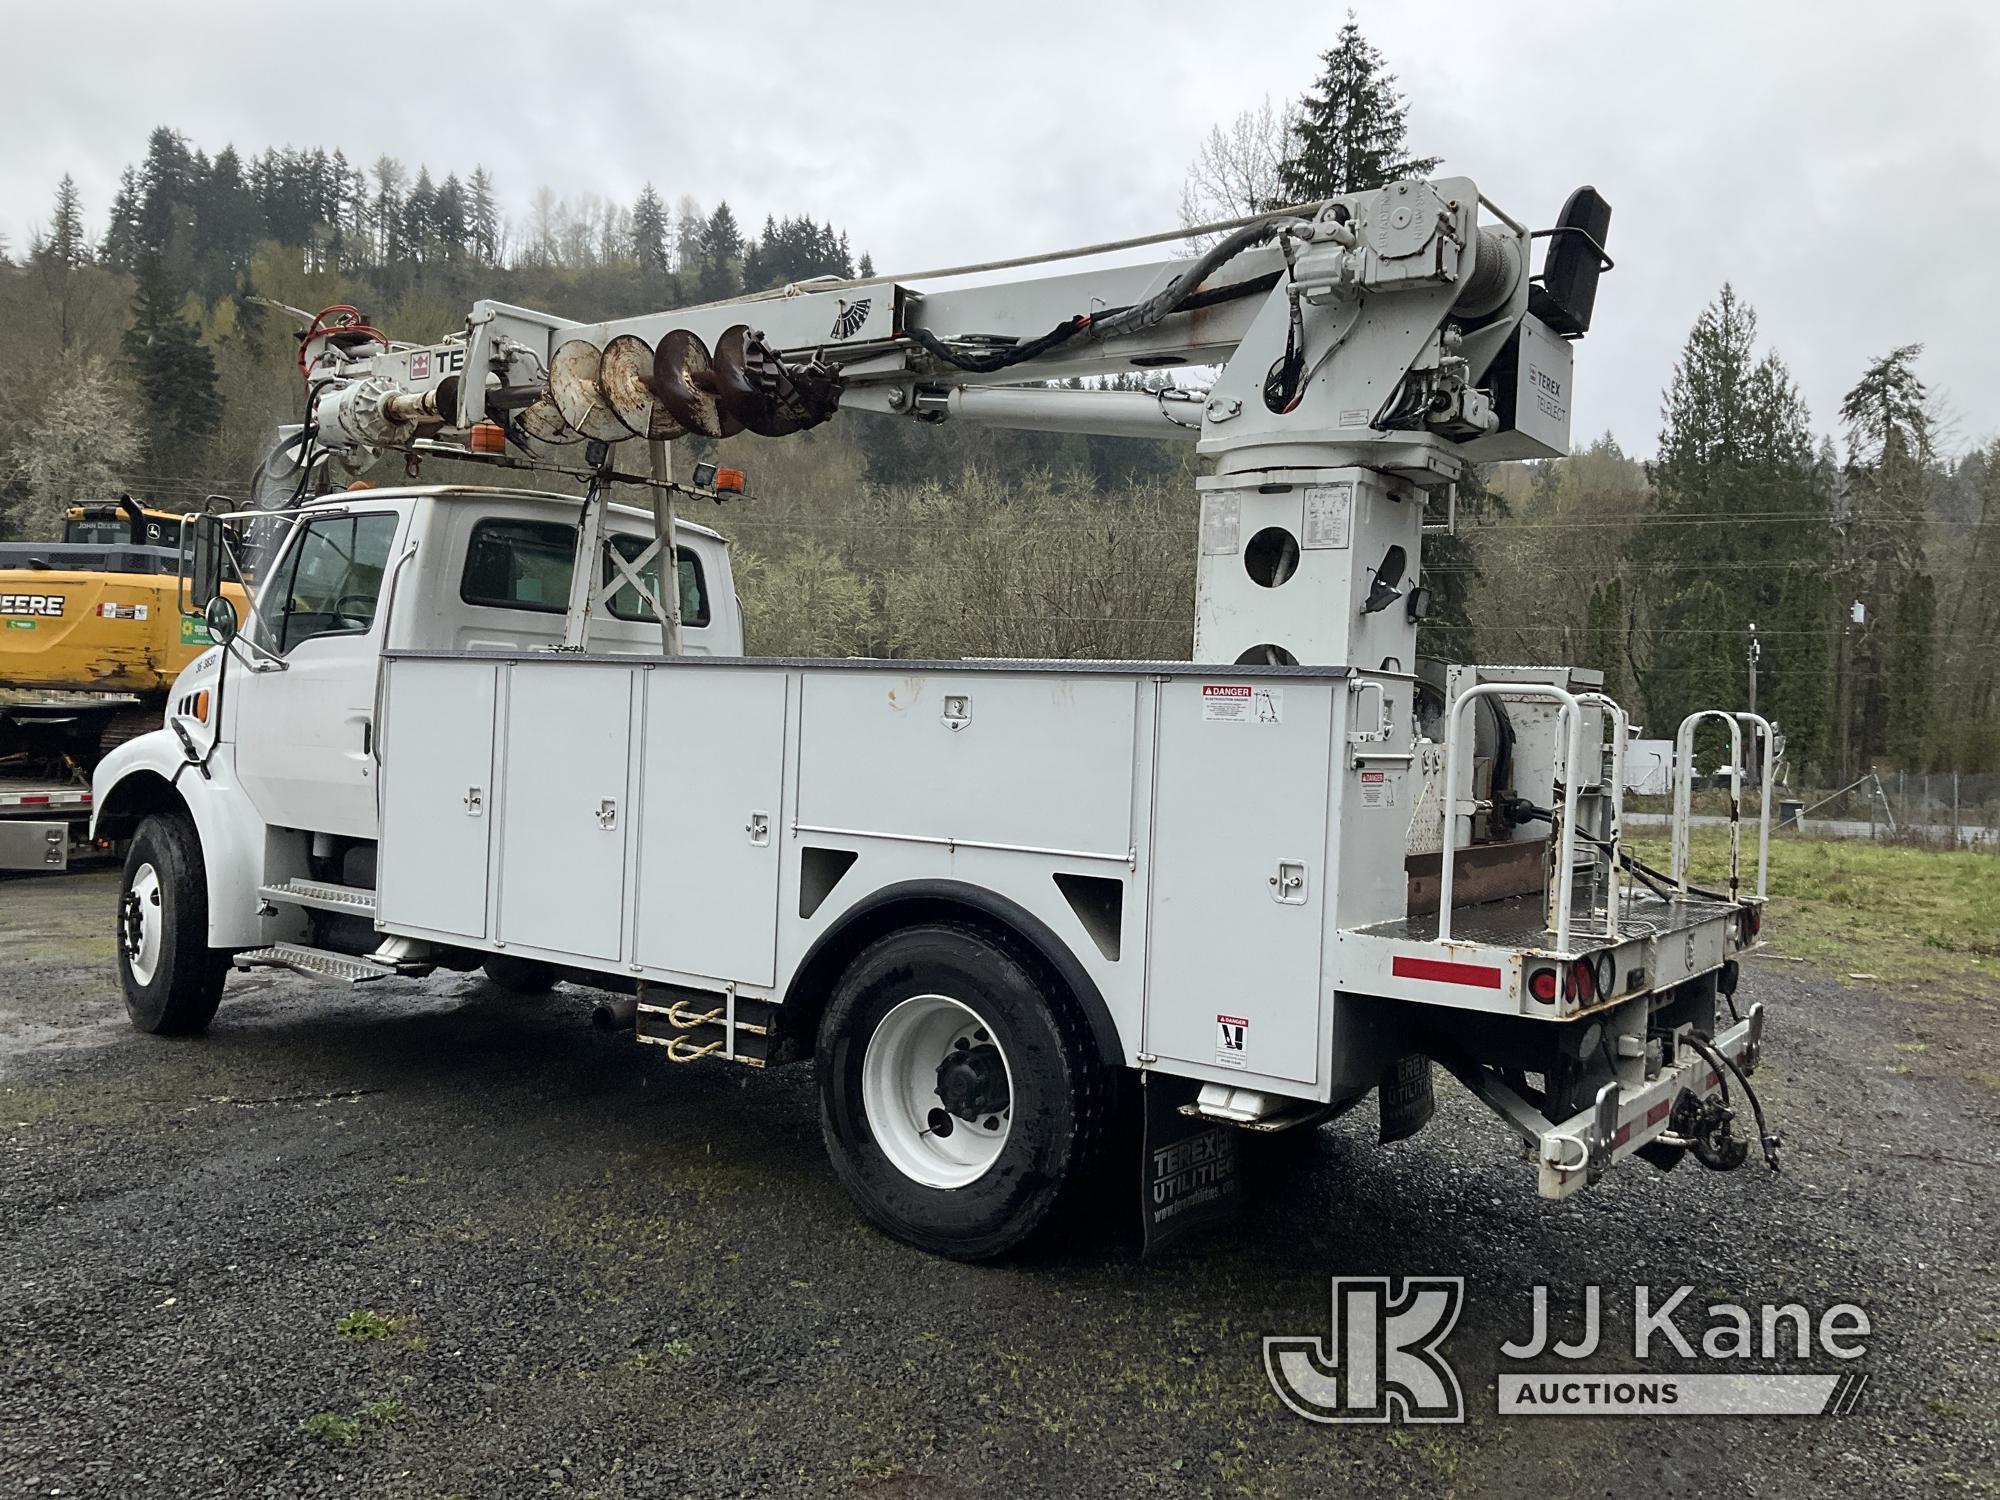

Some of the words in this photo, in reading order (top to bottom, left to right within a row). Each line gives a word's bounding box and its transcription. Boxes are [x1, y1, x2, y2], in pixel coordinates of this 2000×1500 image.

[435, 349, 464, 373] TE
[1537, 370, 1561, 397] TEREX
[78, 521, 97, 529] JOHN
[97, 521, 121, 529] DEERE
[0, 594, 65, 617] EERE
[1212, 687, 1250, 697] DANGER
[1225, 1017, 1247, 1026] DANGER
[1398, 1054, 1427, 1081] EREX
[1153, 1133, 1217, 1178] TEREX
